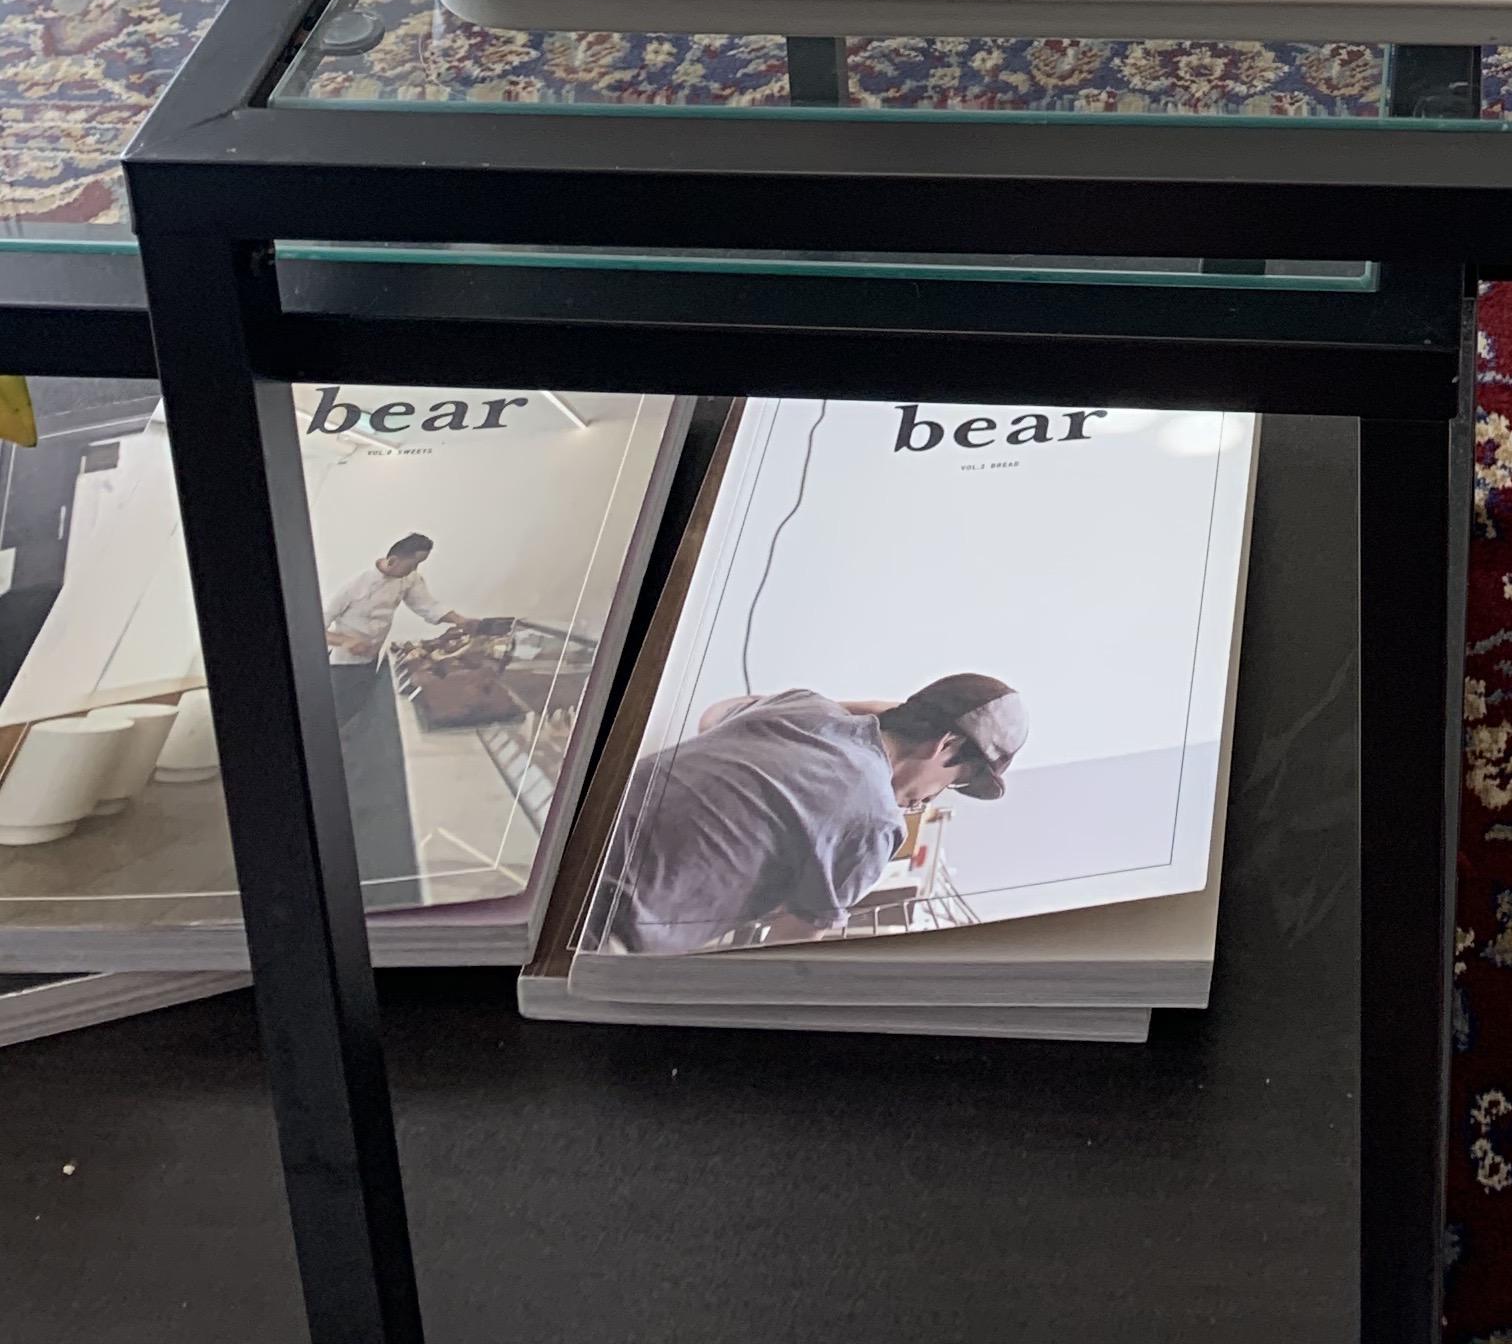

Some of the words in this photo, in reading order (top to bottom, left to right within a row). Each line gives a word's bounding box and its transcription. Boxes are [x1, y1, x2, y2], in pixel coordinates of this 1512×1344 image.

[306, 386, 529, 434] bear
[893, 404, 1108, 453] bear
[990, 461, 1020, 469] BREAD
